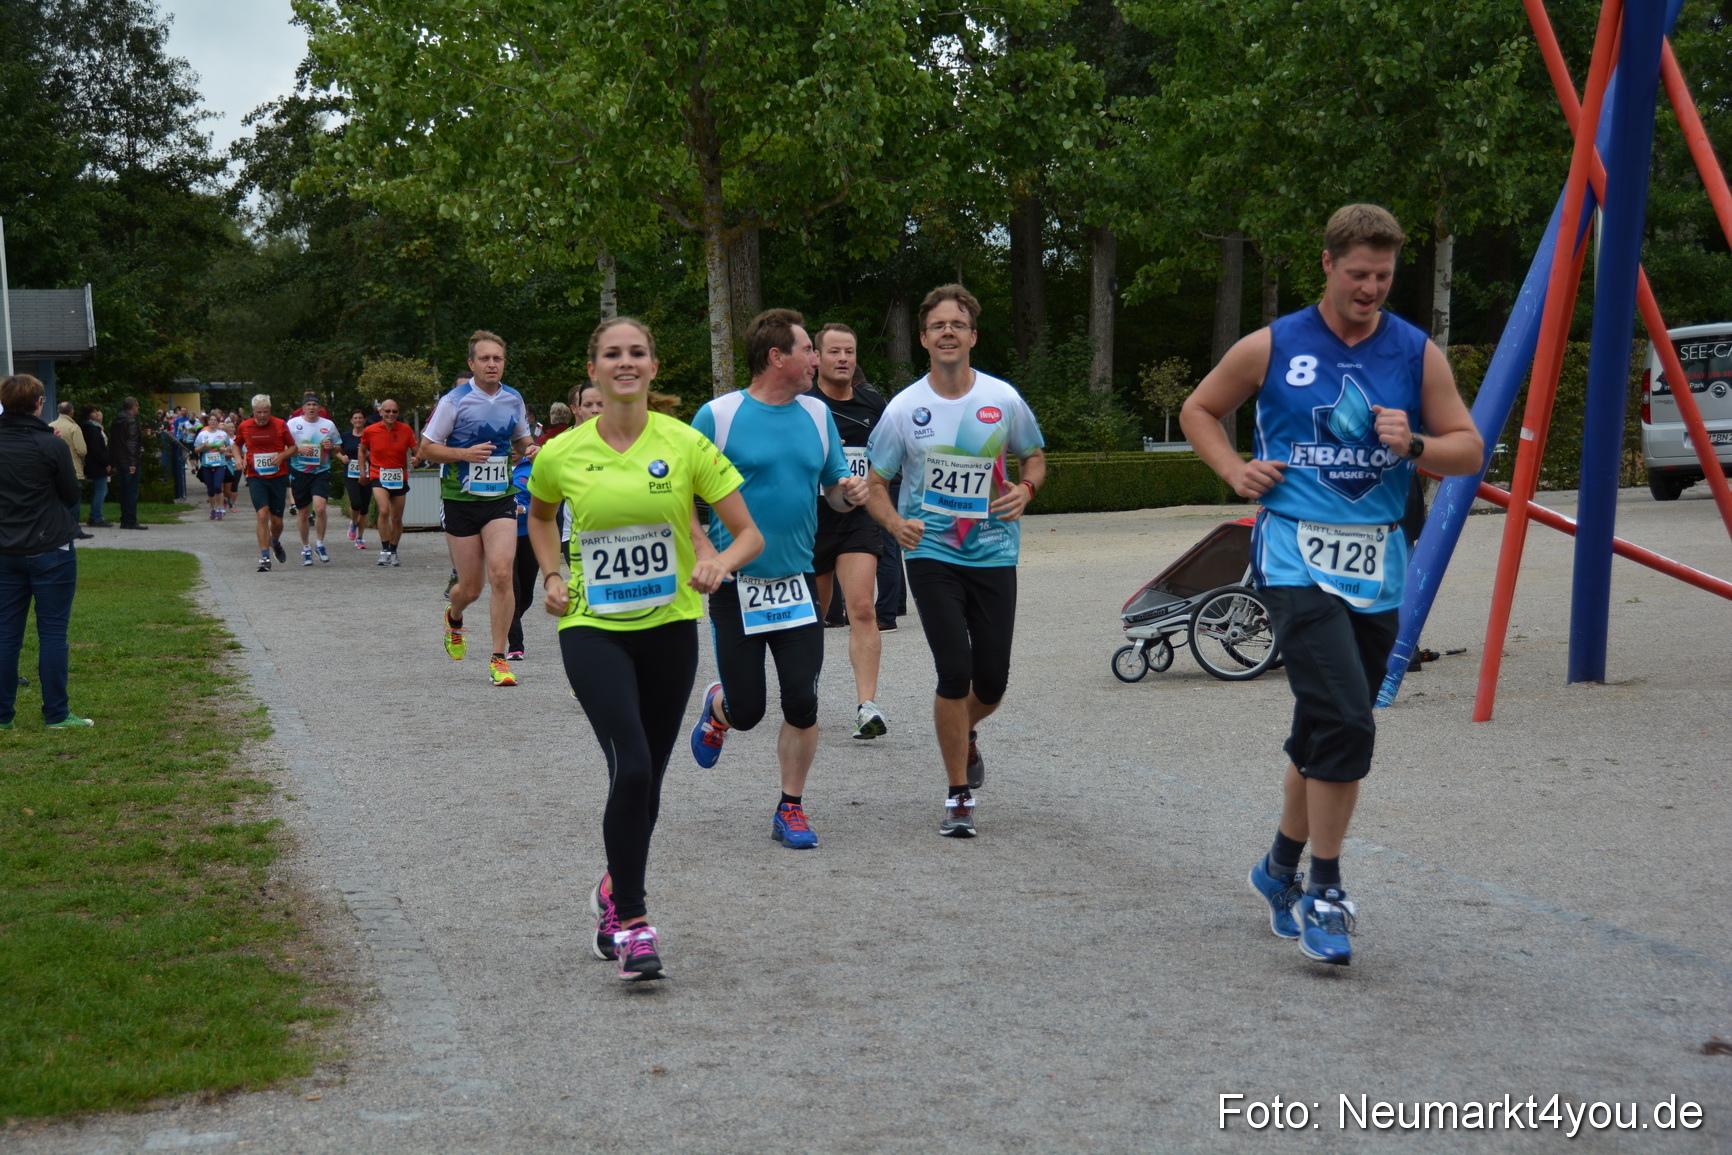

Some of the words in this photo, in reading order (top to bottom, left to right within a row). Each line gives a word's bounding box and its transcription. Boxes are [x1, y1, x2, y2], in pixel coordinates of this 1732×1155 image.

[1286, 355, 1318, 387] 8
[914, 428, 934, 436] PARTL
[927, 458, 949, 467] PARTL
[474, 466, 505, 480] 2114
[931, 468, 986, 494] 2417
[938, 497, 973, 509] Andreas
[1301, 523, 1331, 535] PARTL
[581, 536, 612, 546] PARTL
[614, 530, 658, 543] Neumarkt
[593, 542, 668, 580] 2499
[1307, 537, 1376, 575] 2128
[605, 584, 662, 600] Franziska
[747, 579, 804, 608] 2420
[767, 611, 792, 621] Franz
